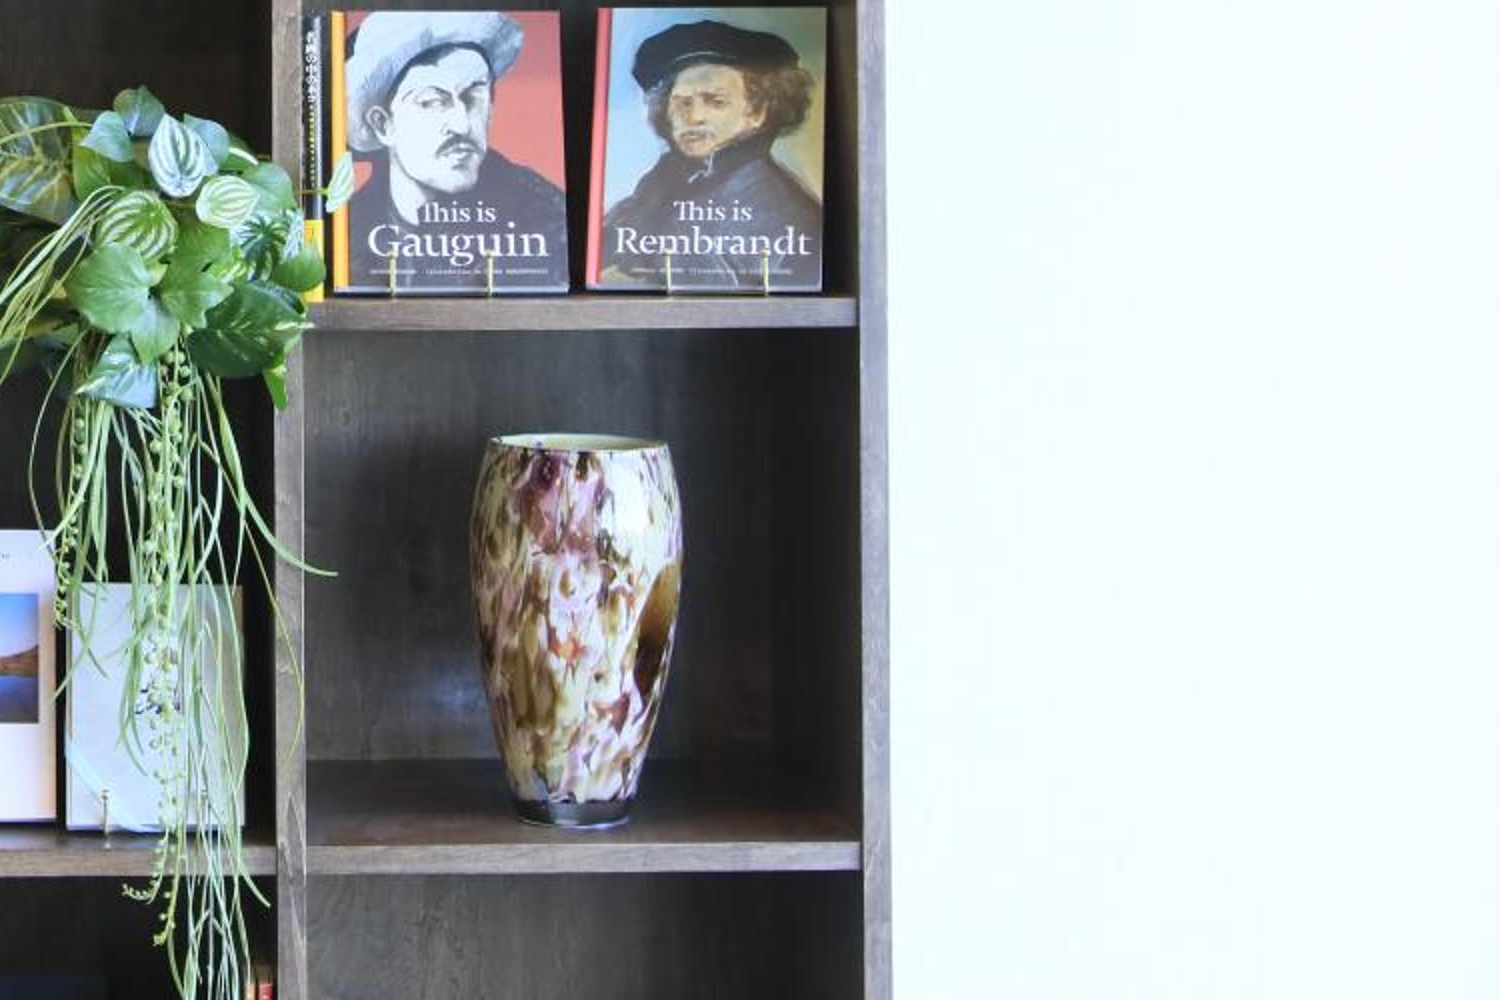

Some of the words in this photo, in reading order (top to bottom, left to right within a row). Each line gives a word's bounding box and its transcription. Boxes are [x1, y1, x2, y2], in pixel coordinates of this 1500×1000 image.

[422, 200, 471, 223] This
[476, 200, 497, 223] is
[673, 199, 725, 222] This
[732, 199, 753, 222] is
[367, 221, 549, 267] Gauguin
[615, 225, 813, 256] Rembrandt
